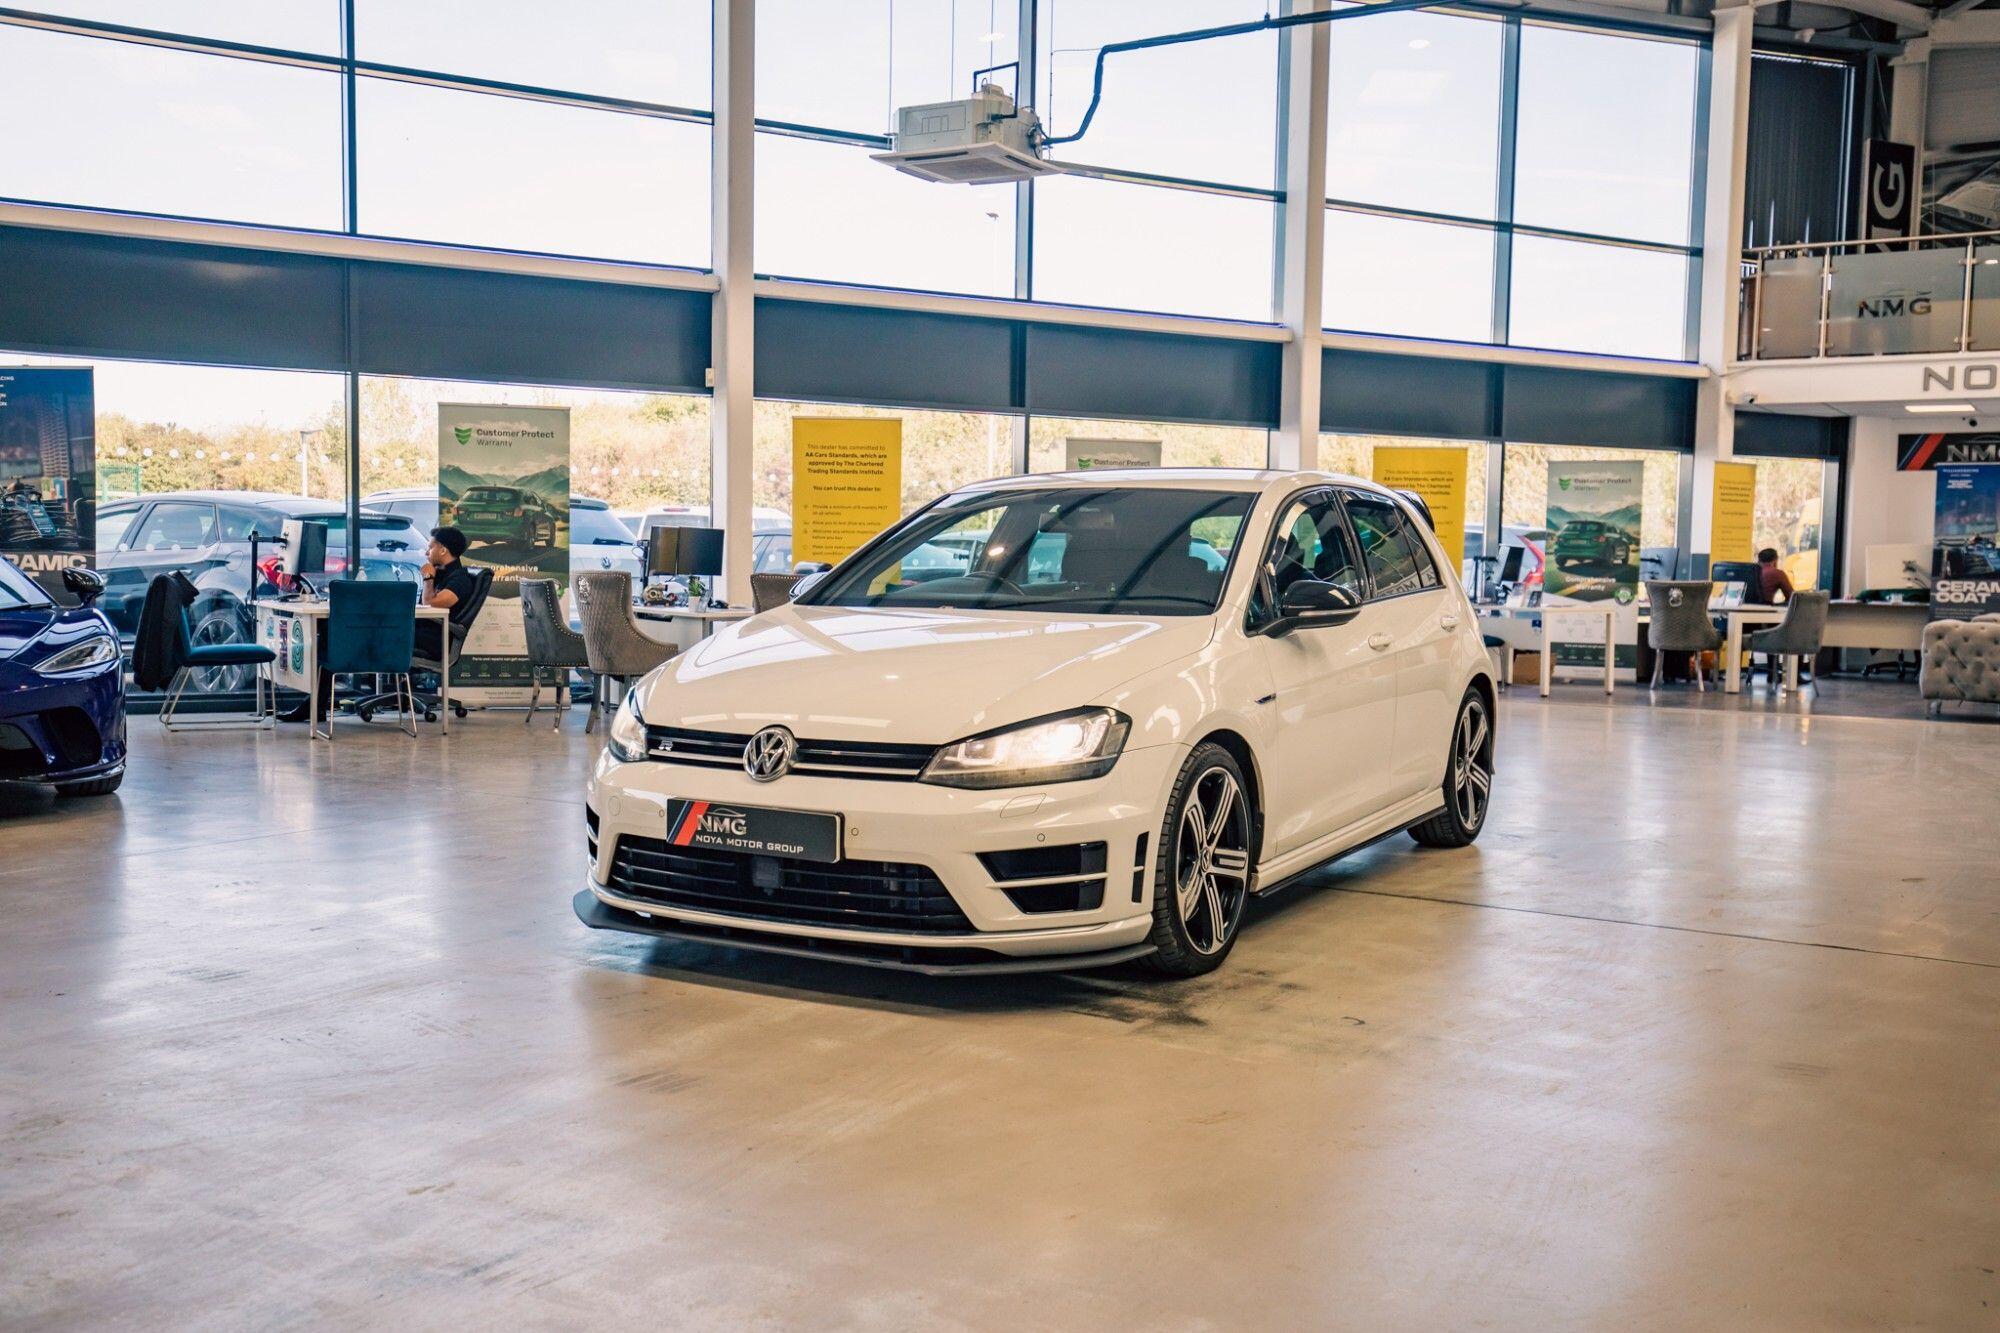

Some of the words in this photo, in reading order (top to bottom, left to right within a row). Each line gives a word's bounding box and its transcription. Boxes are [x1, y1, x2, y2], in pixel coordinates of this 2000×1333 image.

[1858, 298, 1932, 318] NMG
[477, 429, 519, 437] Customer
[521, 430, 554, 438] Protect
[1947, 444, 2000, 462] NM
[3, 553, 87, 571] RAMIC
[697, 814, 747, 835] NMG
[695, 834, 723, 845] NOYA
[726, 838, 763, 850] MOTOR
[767, 842, 804, 854] GROUP
